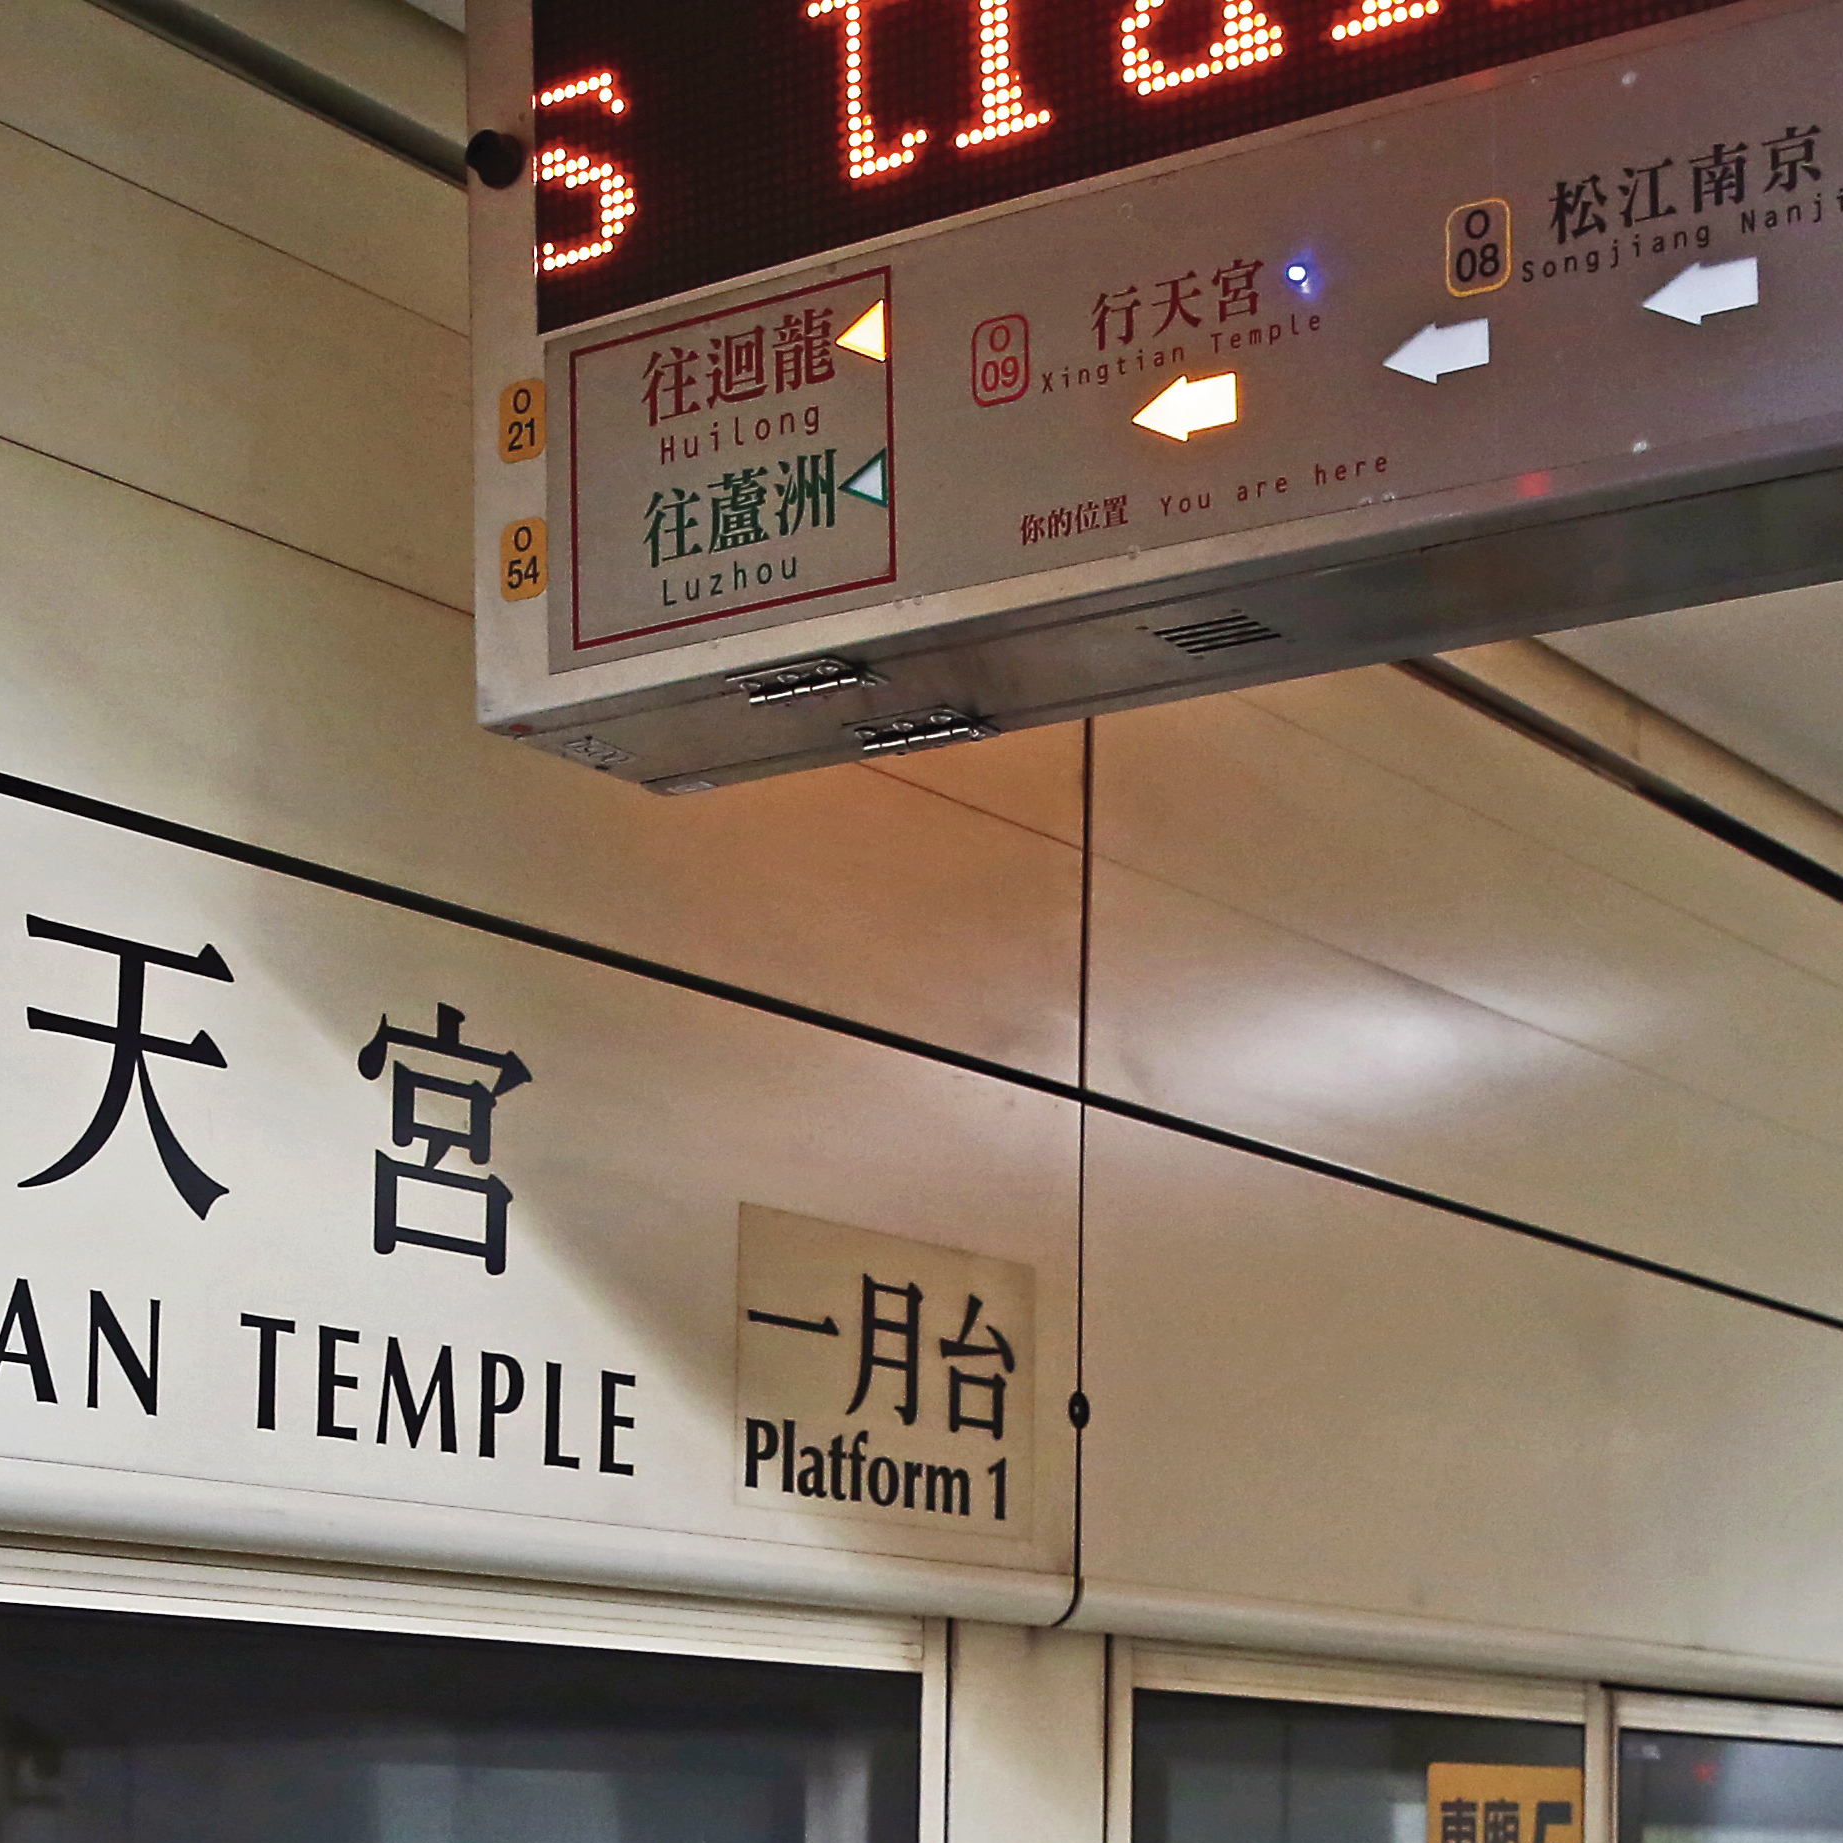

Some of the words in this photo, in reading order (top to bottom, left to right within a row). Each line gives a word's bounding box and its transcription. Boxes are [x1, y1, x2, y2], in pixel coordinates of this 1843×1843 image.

[1550, 124, 1821, 245] 松江南京
[1457, 243, 1500, 283] 08
[1521, 225, 1710, 283] Songjiang
[1090, 258, 1265, 352] 行天宮
[641, 307, 837, 428] 往迴龍
[980, 356, 1019, 393] 09
[1041, 345, 1185, 394] Xingtian
[1210, 312, 1322, 354] Temple
[507, 419, 536, 452] 21
[660, 404, 821, 465] Huilong
[642, 448, 838, 569] 往蘆洲
[1019, 494, 1129, 546] 你的位置
[1160, 489, 1211, 518] You
[1237, 474, 1288, 502] are
[1314, 455, 1389, 486] here
[507, 556, 541, 590] 54
[662, 554, 798, 607] Luzhou
[240, 1310, 637, 1478] TEMPLE
[747, 1273, 1016, 1440] 一月台
[744, 1416, 972, 1517] Platform
[987, 1457, 1007, 1521] 1
